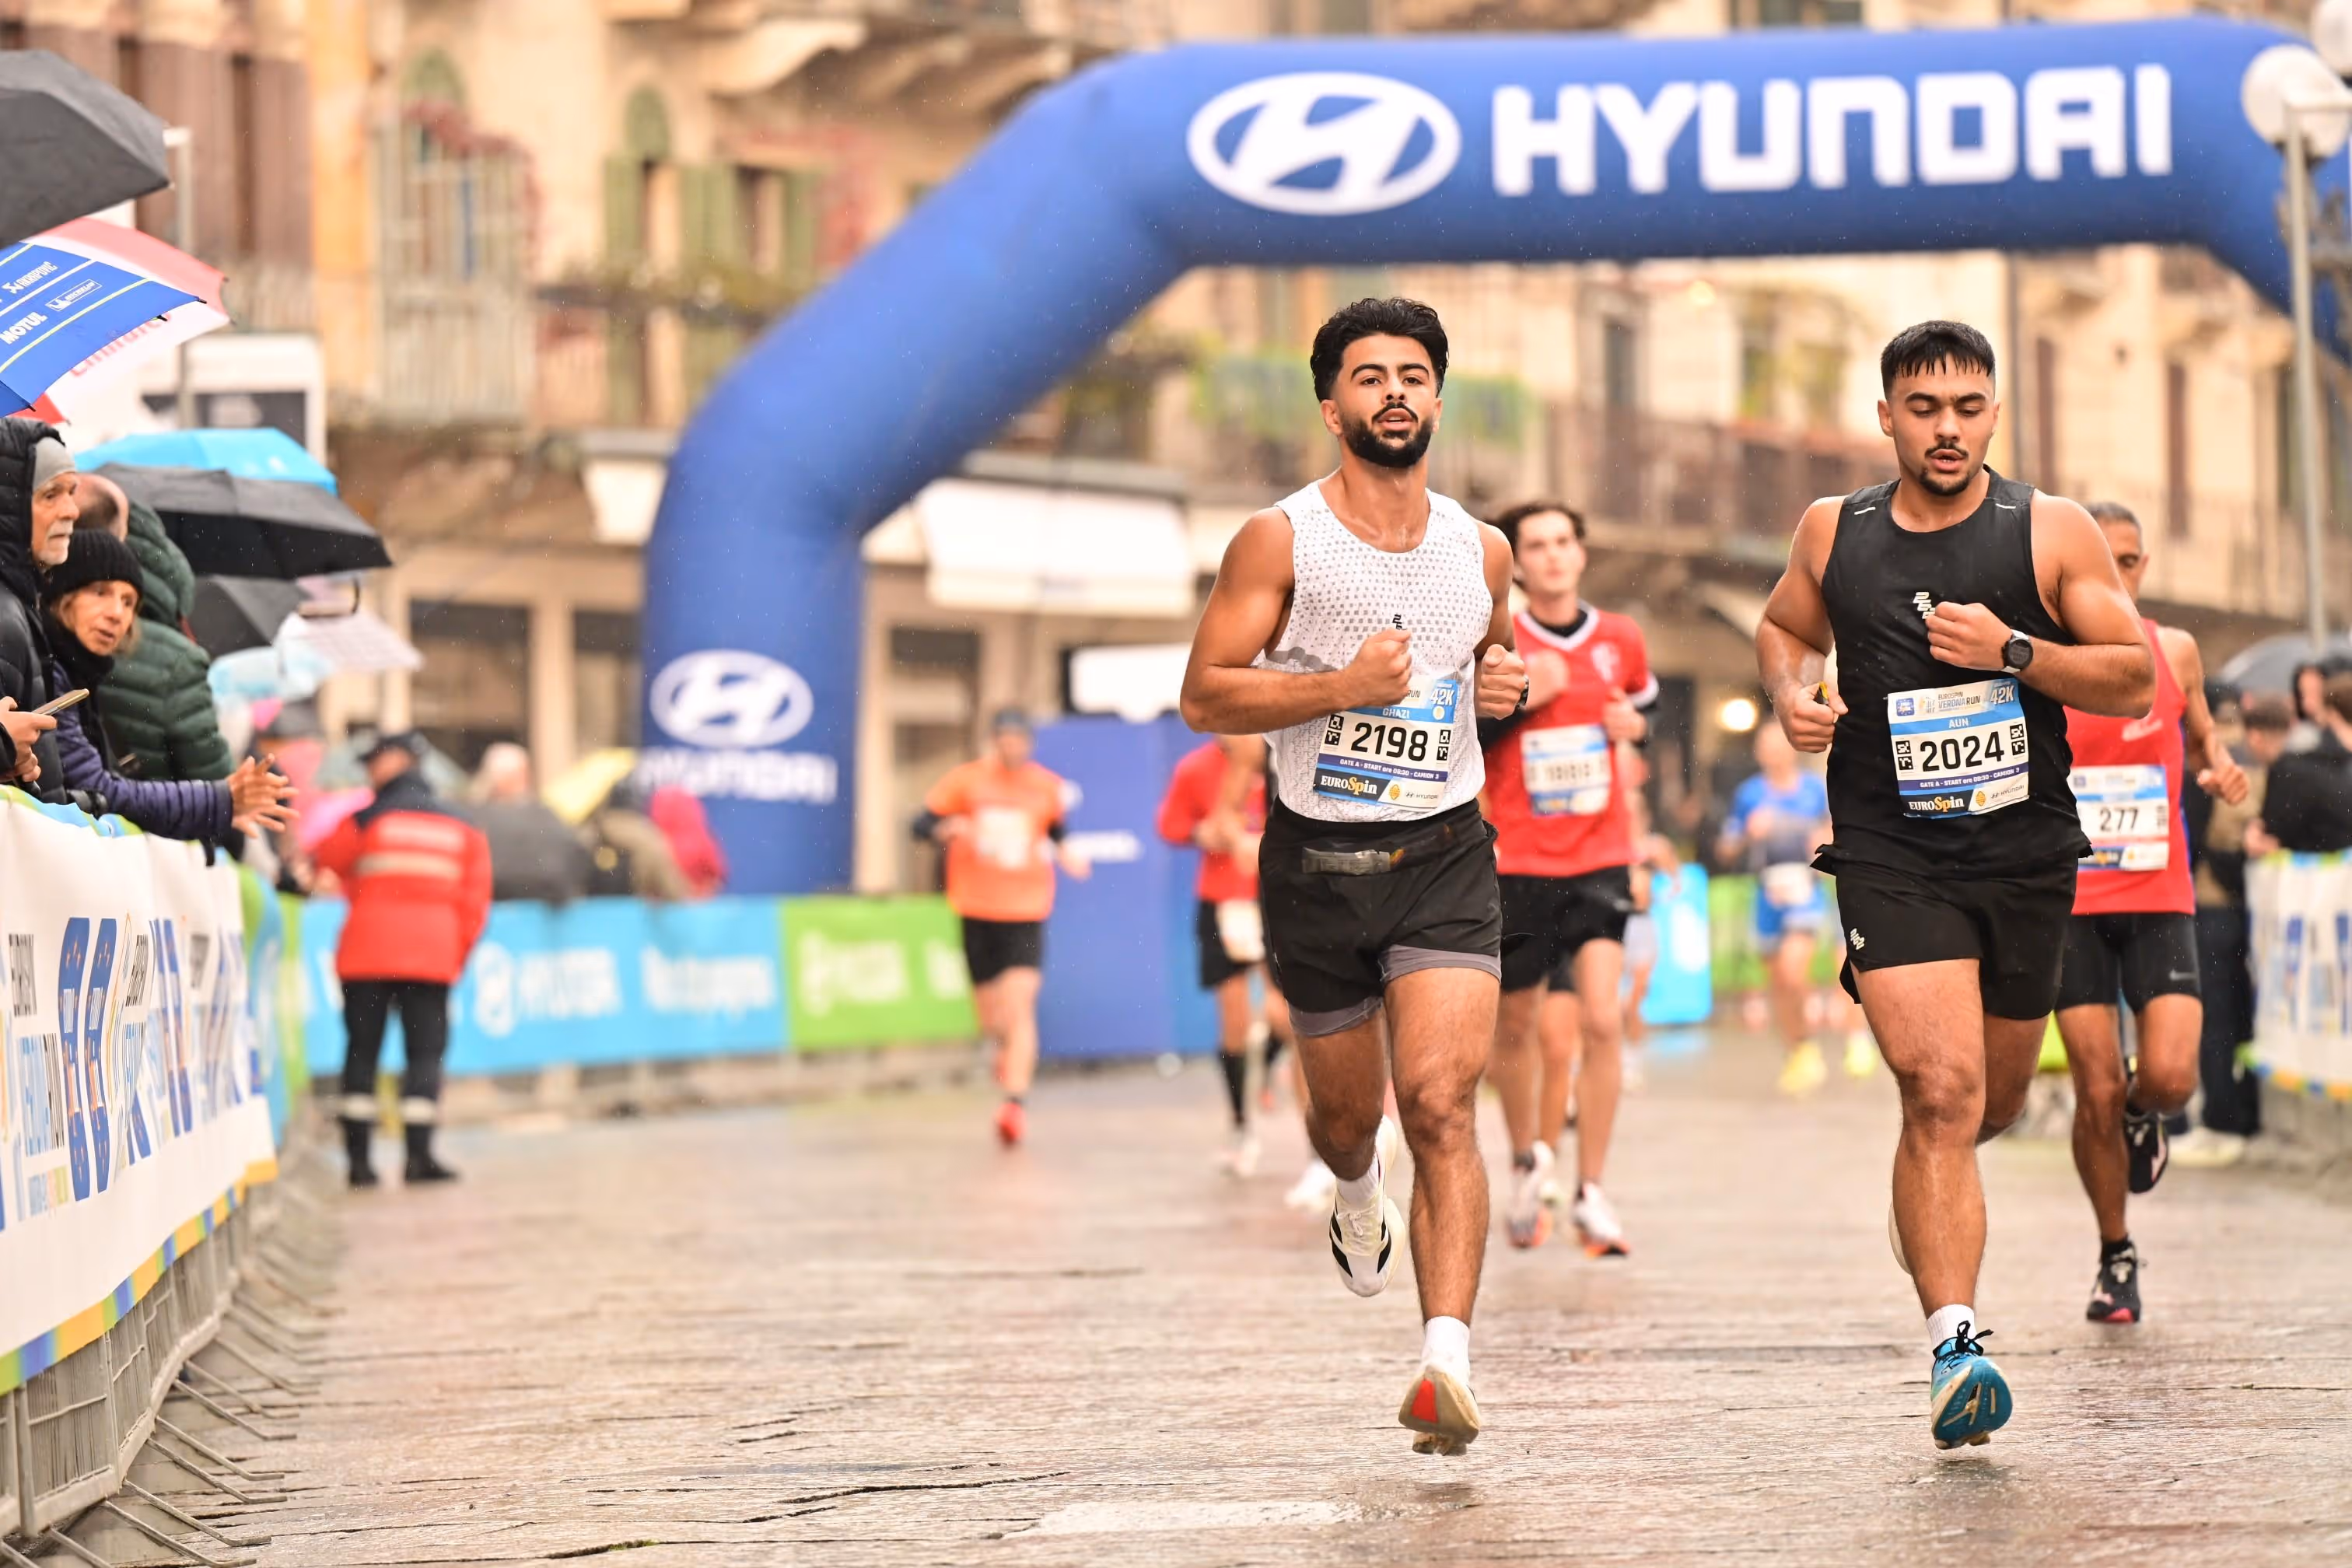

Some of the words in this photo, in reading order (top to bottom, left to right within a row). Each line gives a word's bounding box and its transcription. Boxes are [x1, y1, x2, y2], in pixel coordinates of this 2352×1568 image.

[1493, 64, 2172, 198] HYUNDAI
[0, 311, 48, 345] MOTUL
[1406, 689, 1421, 698] RUN
[1431, 688, 1454, 705] 42K
[1937, 698, 1965, 709] VERONA
[1966, 695, 1980, 705] RUN
[1938, 691, 1964, 700] EUROSPIN
[1990, 685, 2014, 705] 42K
[1383, 708, 1410, 719] GHAZI
[1948, 717, 1969, 729] AUN
[1350, 722, 1429, 762] 2198
[1920, 731, 2004, 772] 2024
[1339, 758, 1354, 767] GATE
[1363, 762, 1381, 772] START
[1321, 775, 1377, 795] EUROSpin
[1908, 796, 1965, 812] EUROSpin
[2099, 807, 2139, 832] 277
